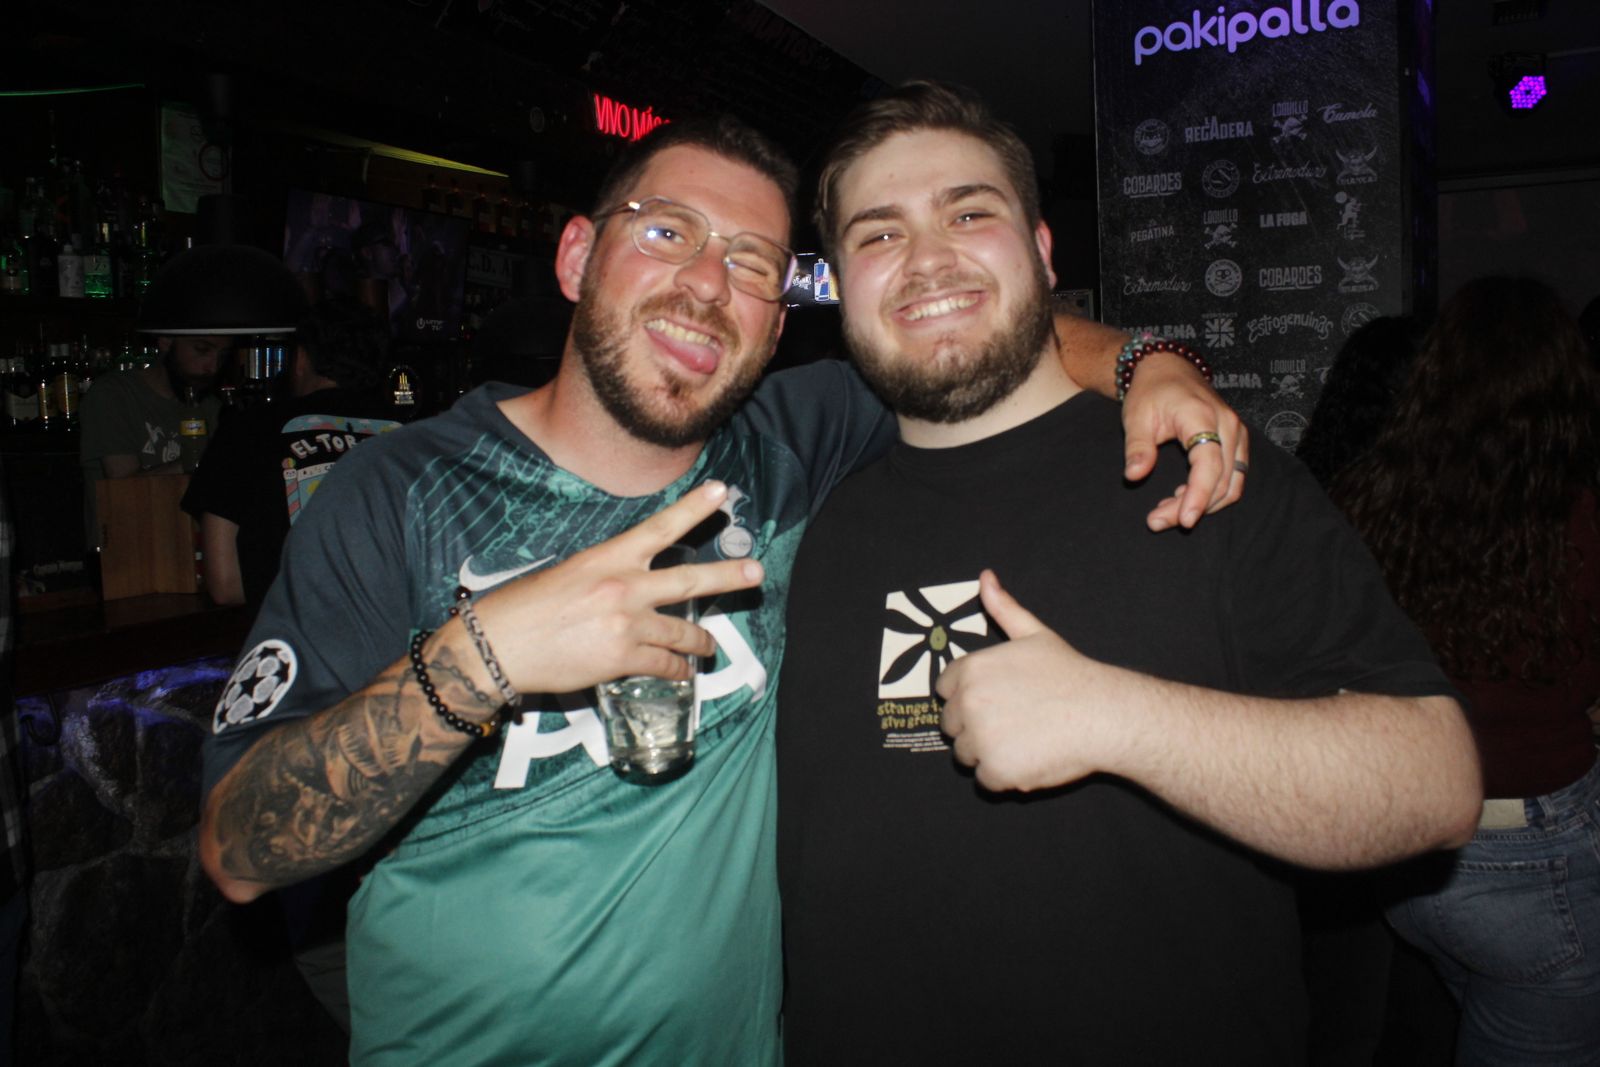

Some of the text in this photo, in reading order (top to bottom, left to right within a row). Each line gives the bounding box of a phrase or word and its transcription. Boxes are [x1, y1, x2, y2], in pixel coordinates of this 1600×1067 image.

[1134, 0, 1360, 65] pakipalla
[1122, 171, 1182, 199] COBARDES
[1130, 224, 1175, 243] PEGATINA
[1259, 214, 1275, 228] LA
[1259, 264, 1322, 291] COBARDES
[1247, 310, 1334, 344] Estrogenuinas
[290, 433, 358, 460] EL TOR
[877, 700, 930, 717] strange
[881, 716, 906, 730] give
